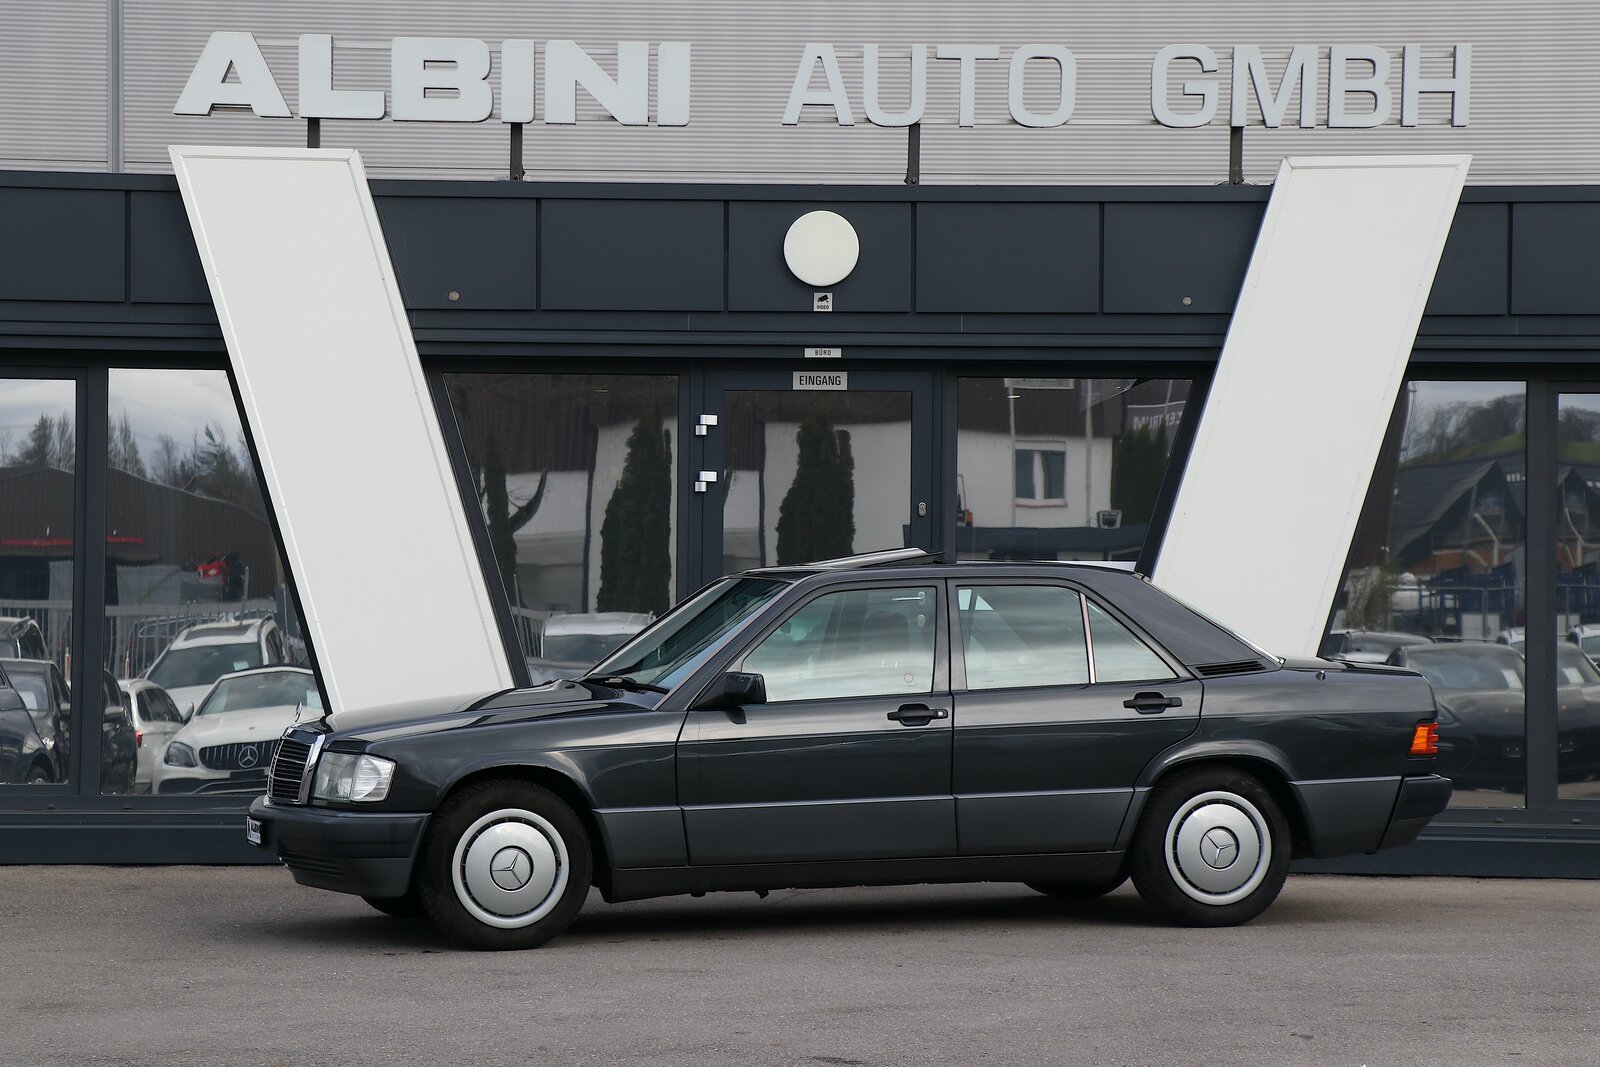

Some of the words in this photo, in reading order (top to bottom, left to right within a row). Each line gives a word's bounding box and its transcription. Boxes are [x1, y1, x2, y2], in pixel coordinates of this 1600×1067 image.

[172, 31, 691, 126] ALBINI
[782, 42, 1077, 128] AUTO
[1151, 43, 1473, 128] GMBH
[814, 348, 832, 356] BÜRO
[799, 375, 842, 386] EINGANG
